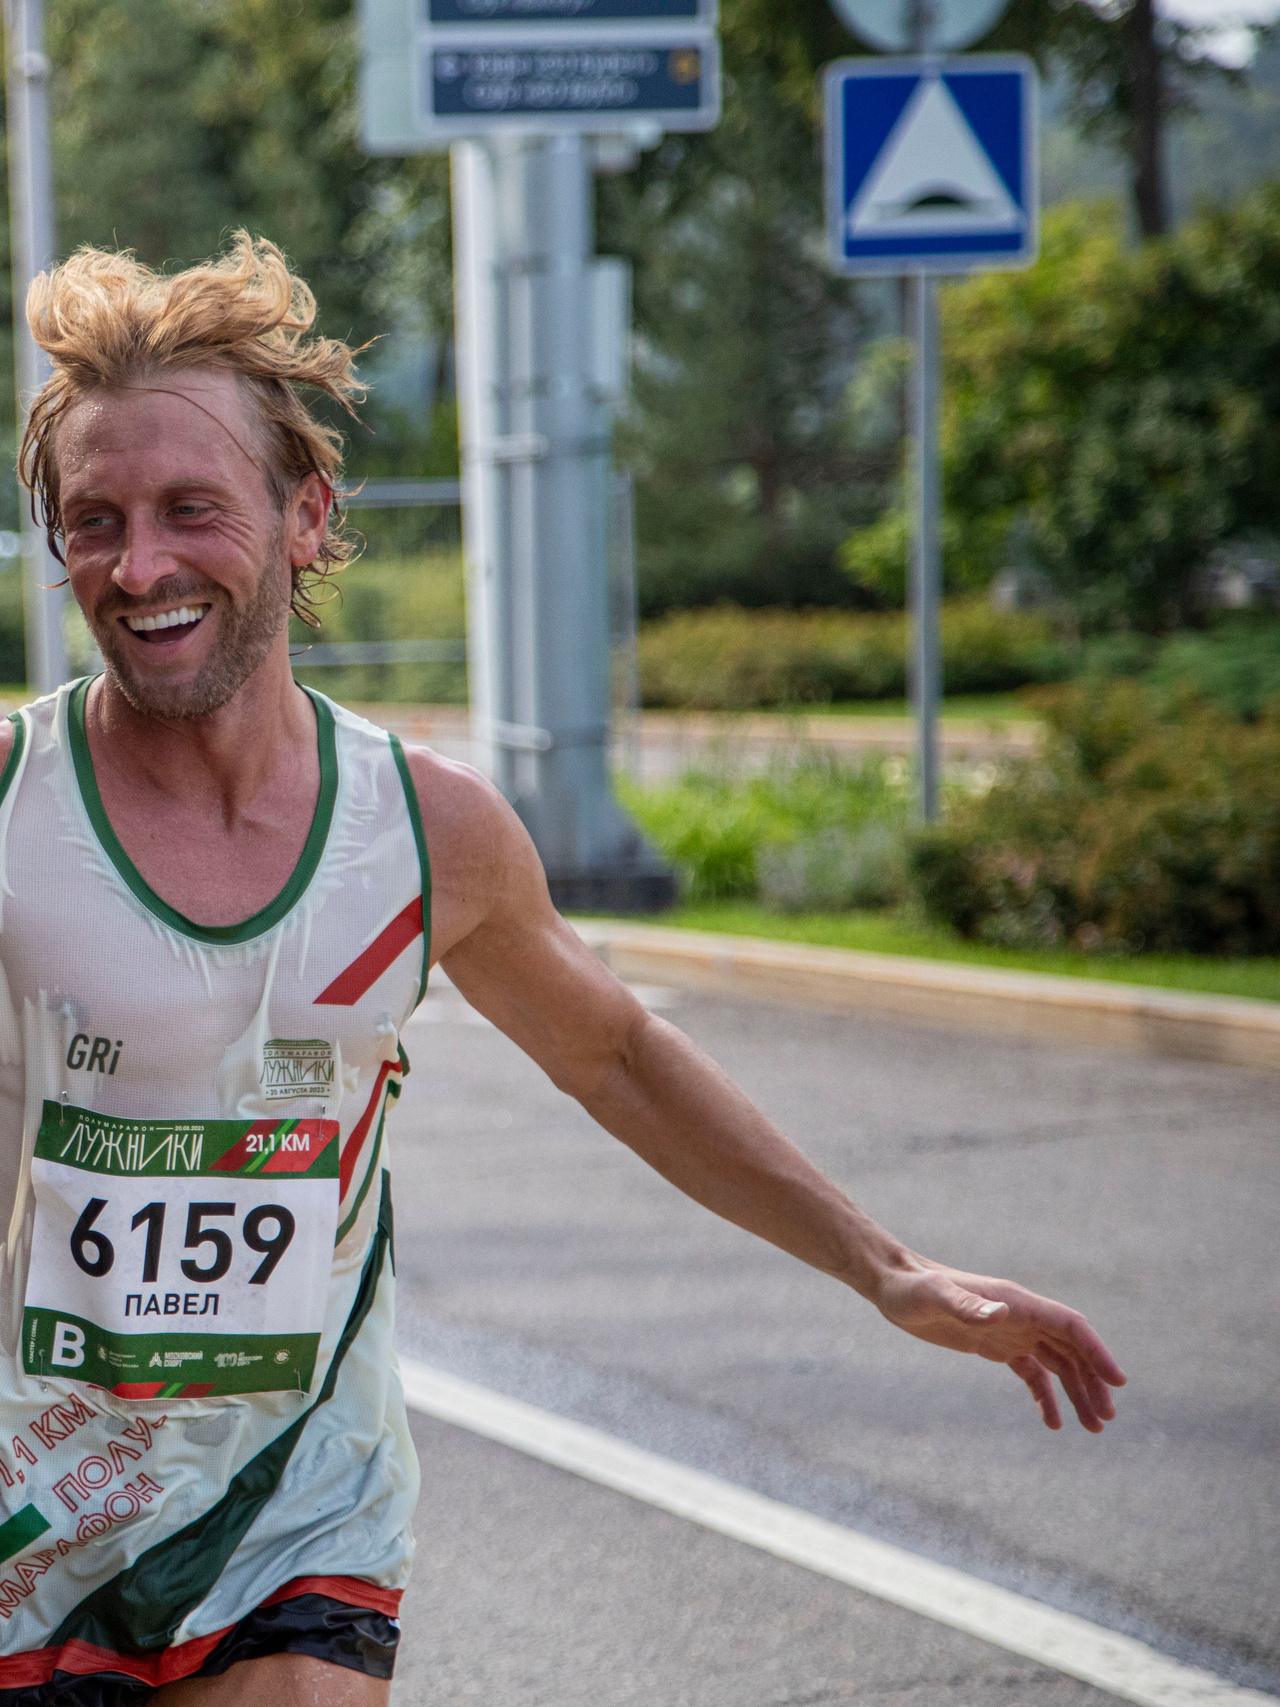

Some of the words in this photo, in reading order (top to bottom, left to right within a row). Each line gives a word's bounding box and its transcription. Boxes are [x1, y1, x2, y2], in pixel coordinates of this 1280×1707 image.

[66, 1033, 123, 1075] GRi
[260, 1060, 335, 1084] ЛУЖНИКИ
[270, 1088, 278, 1096] 20
[280, 1086, 308, 1095] АВГУСТА
[79, 1114, 155, 1132] ПОЛУМАРАФОН
[60, 1122, 204, 1171] ЛУЖНИКИ
[245, 1133, 276, 1155] 21,1
[70, 1197, 297, 1286] 6159
[124, 1293, 220, 1317] ПАВЕЛ
[52, 1415, 168, 1512] ПОЛУ-
